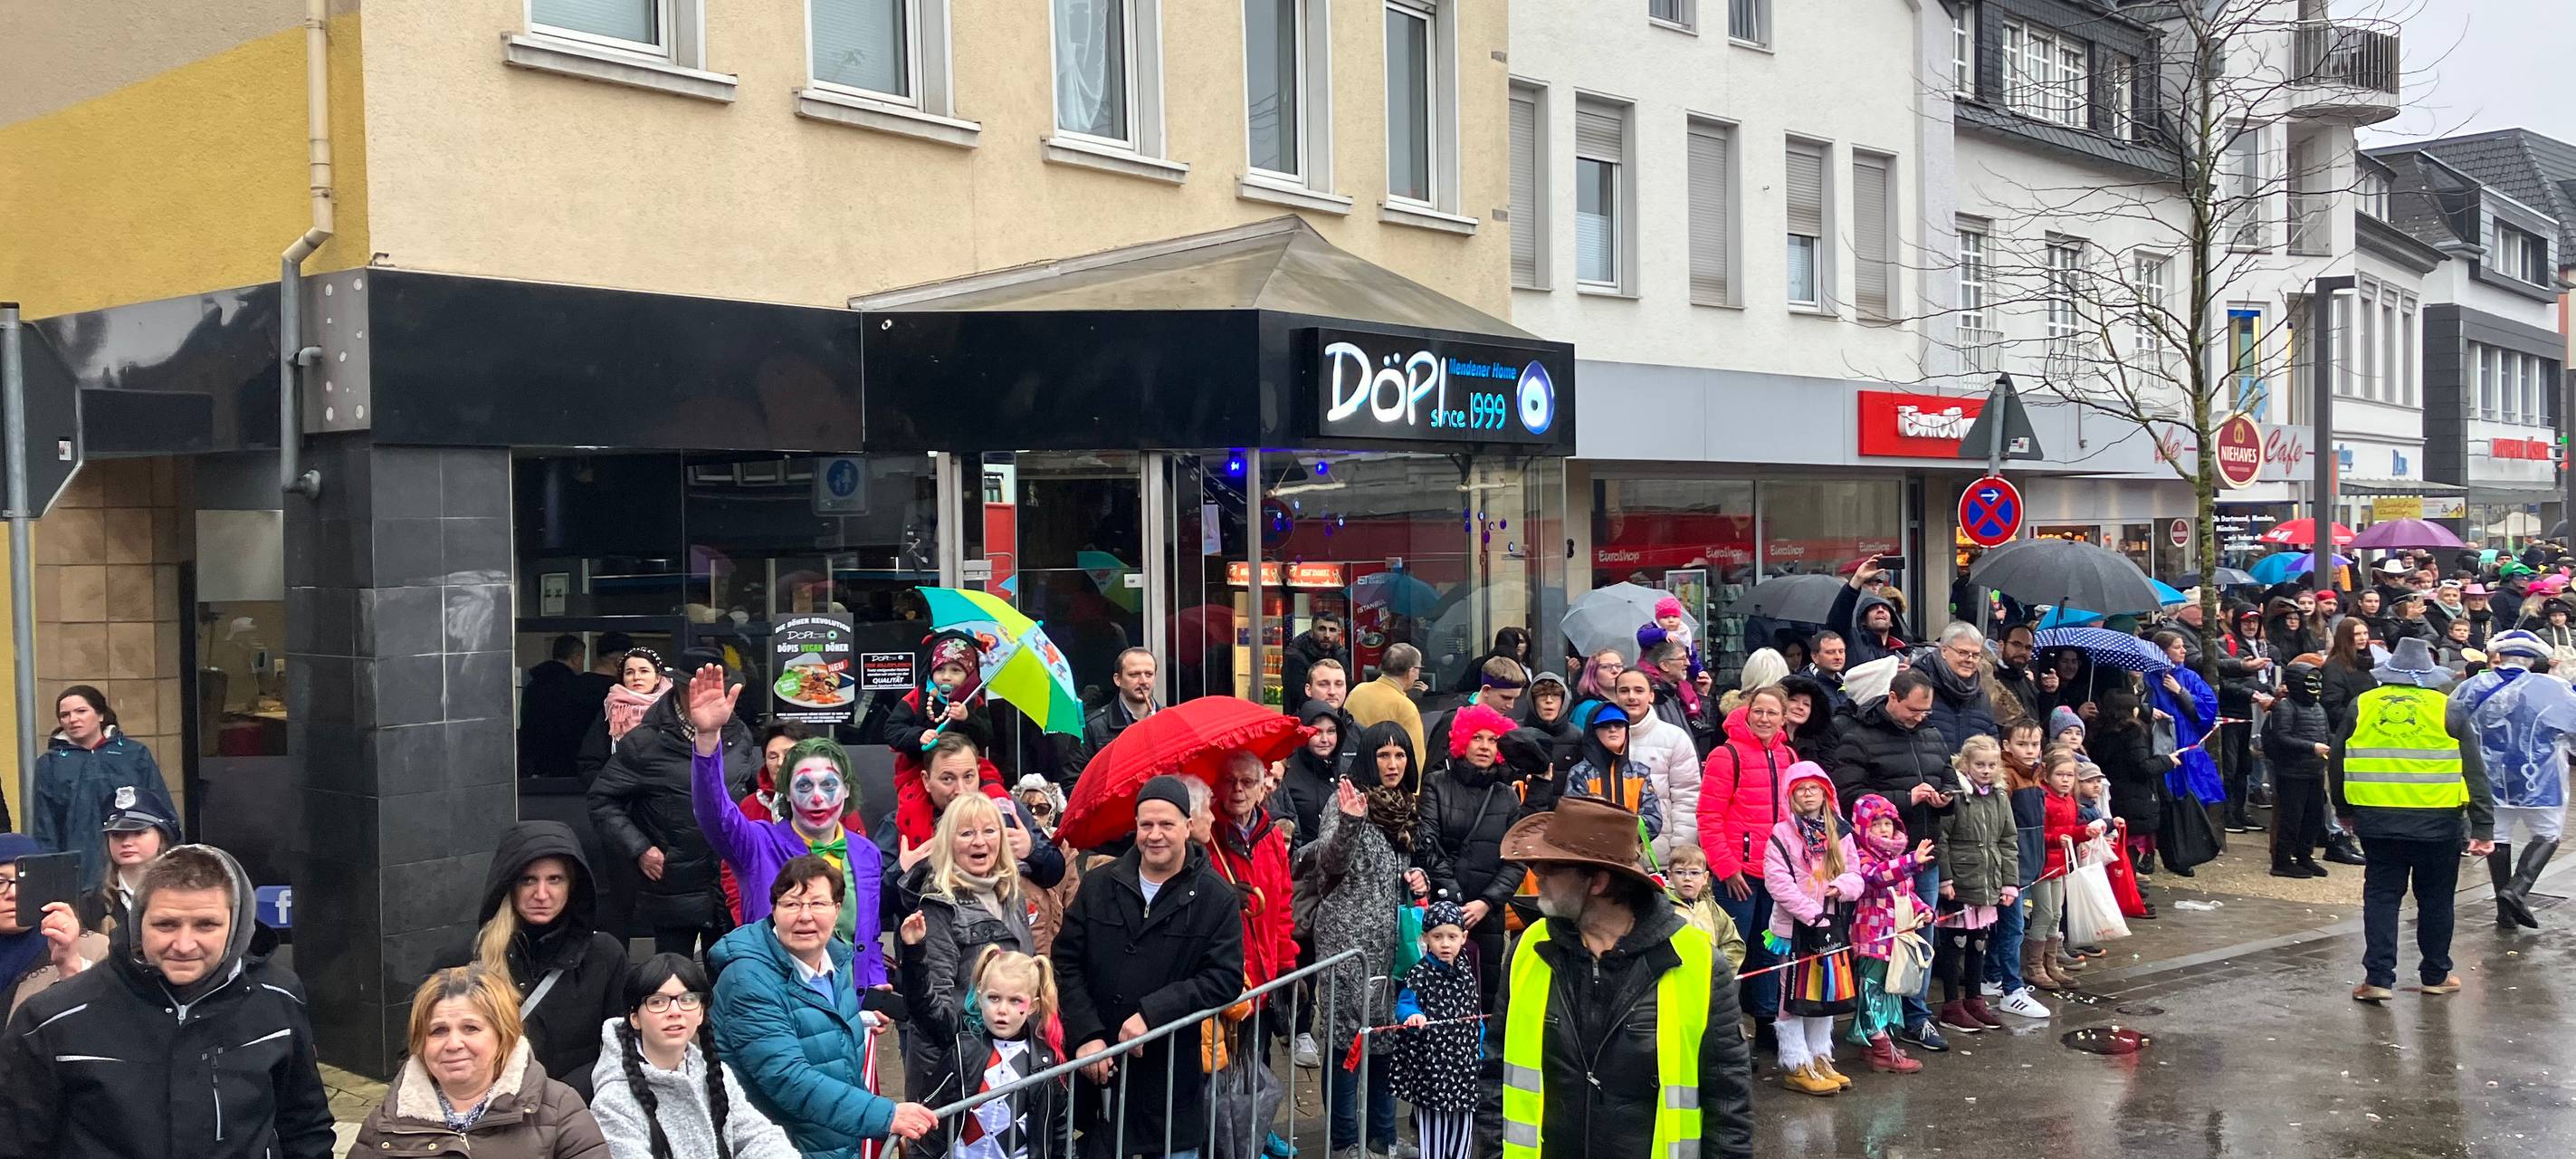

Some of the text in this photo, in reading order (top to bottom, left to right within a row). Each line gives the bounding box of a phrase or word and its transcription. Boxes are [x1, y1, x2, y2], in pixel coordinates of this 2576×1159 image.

[1449, 358, 1517, 380] Mendener Home
[1430, 392, 1506, 429] since 1999
[2220, 445, 2257, 464] NIEHAVES
[811, 617, 851, 633] REVOLUTION
[777, 642, 799, 653] DÖPIS
[825, 641, 849, 652] DÖNER
[872, 675, 904, 685] QUALITÄT
